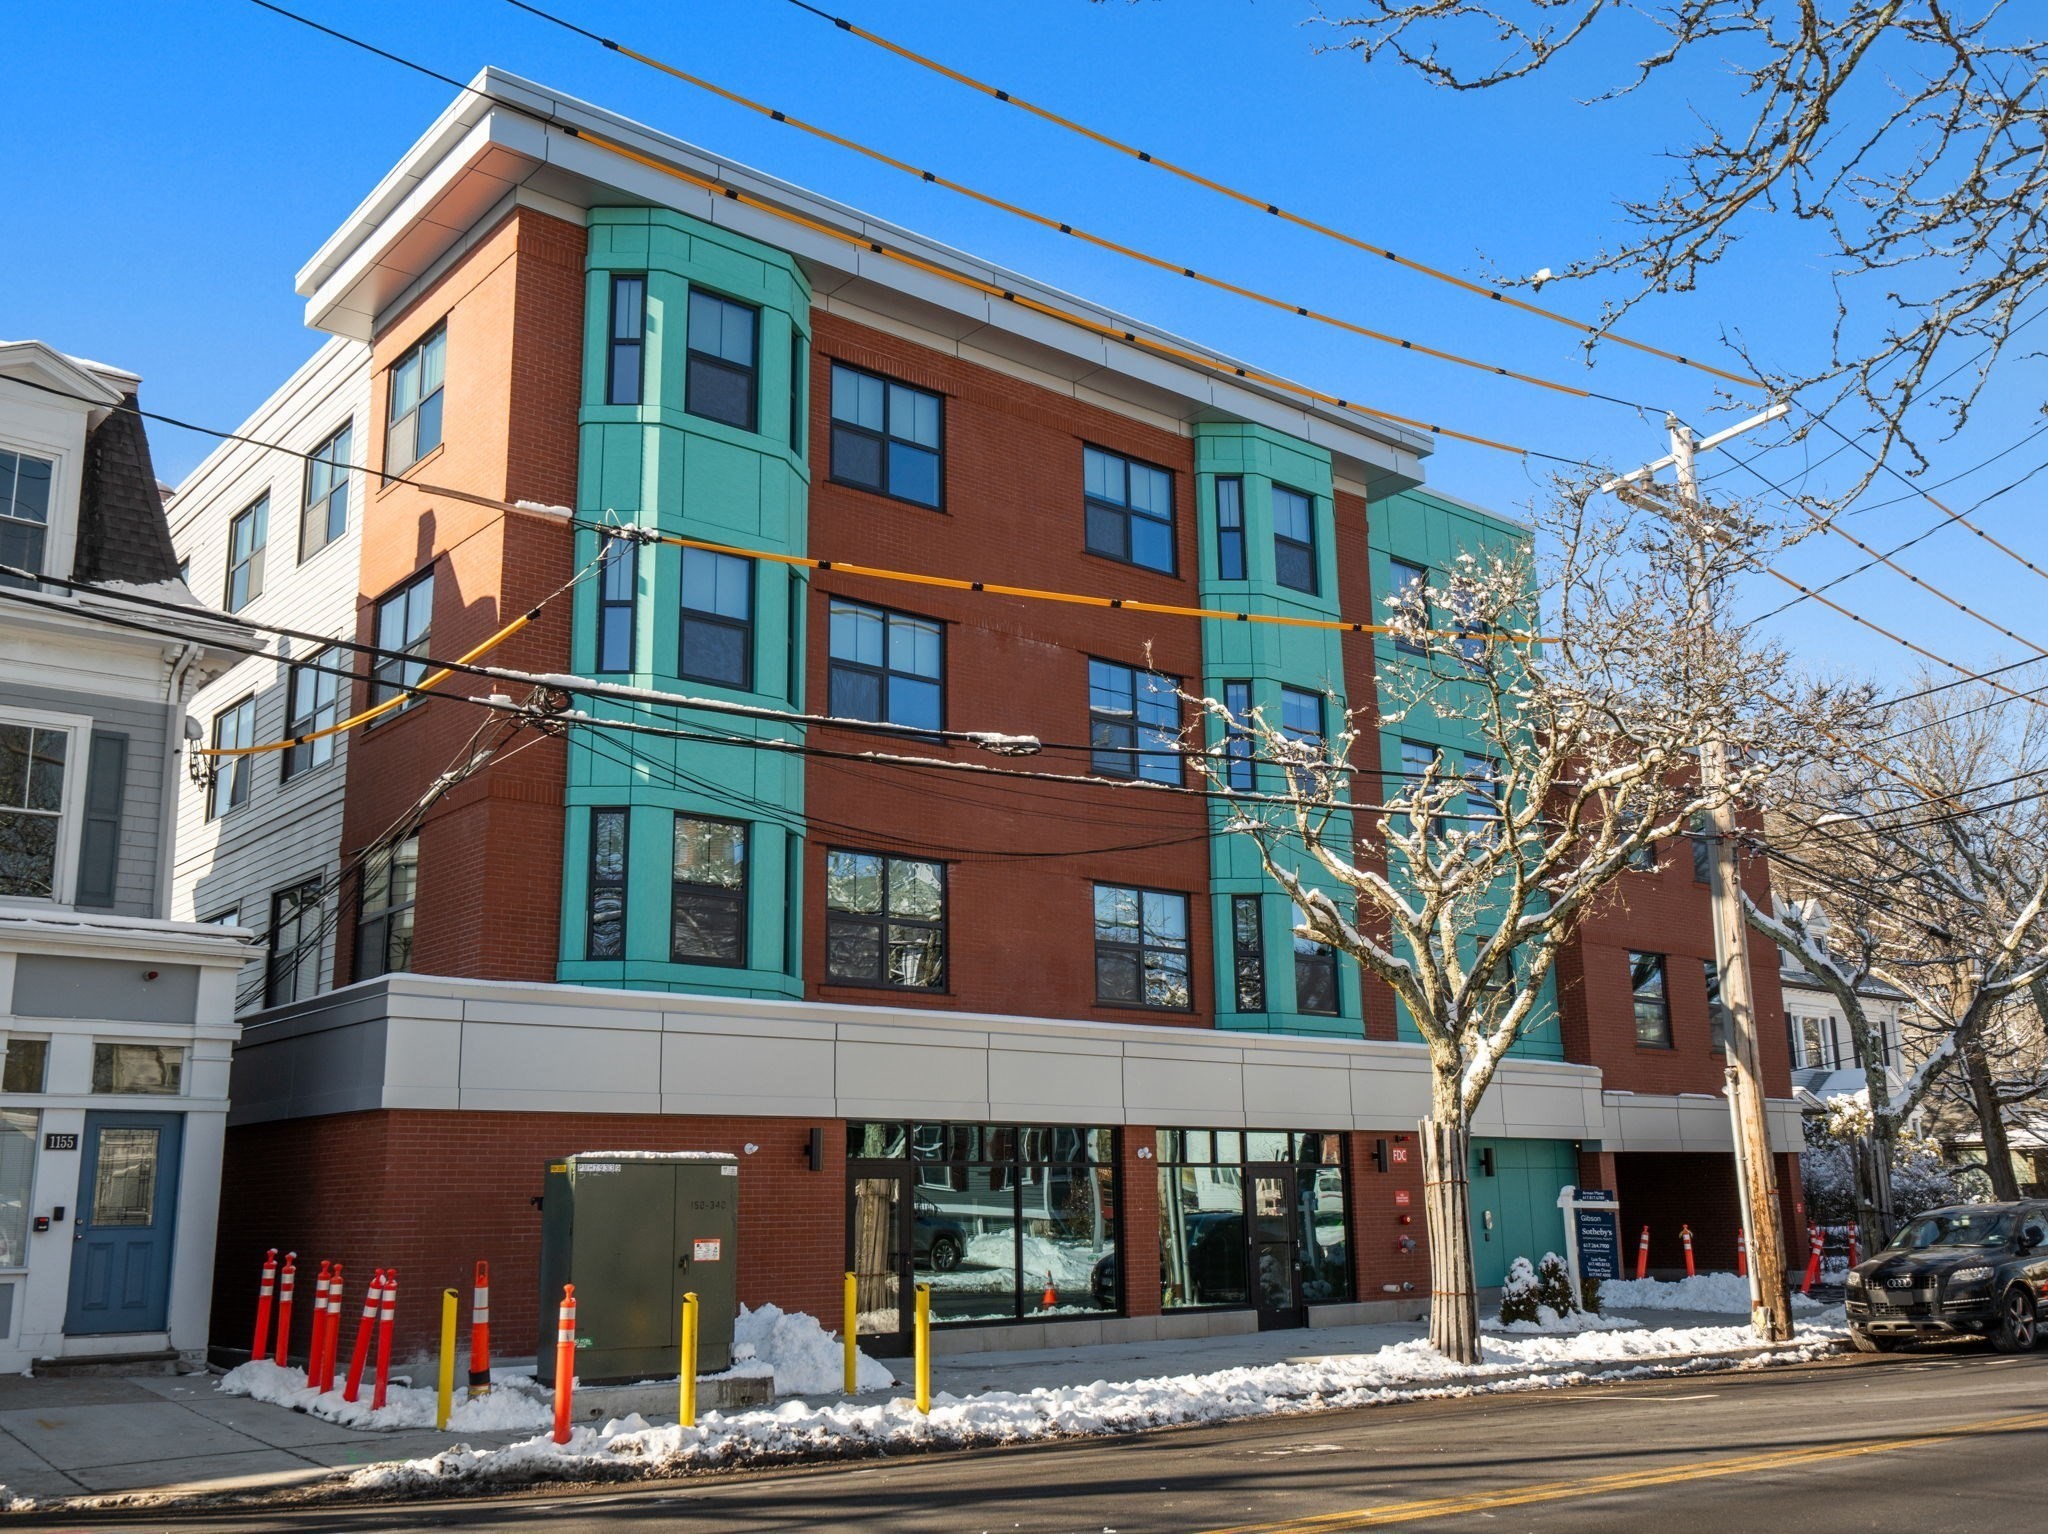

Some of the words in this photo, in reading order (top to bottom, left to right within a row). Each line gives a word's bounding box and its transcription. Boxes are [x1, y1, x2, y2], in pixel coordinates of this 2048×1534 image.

[50, 1135, 75, 1149] 1155
[1393, 1149, 1407, 1161] FDC
[1581, 1214, 1602, 1222] Gibson
[1582, 1228, 1613, 1238] Sotheby's
